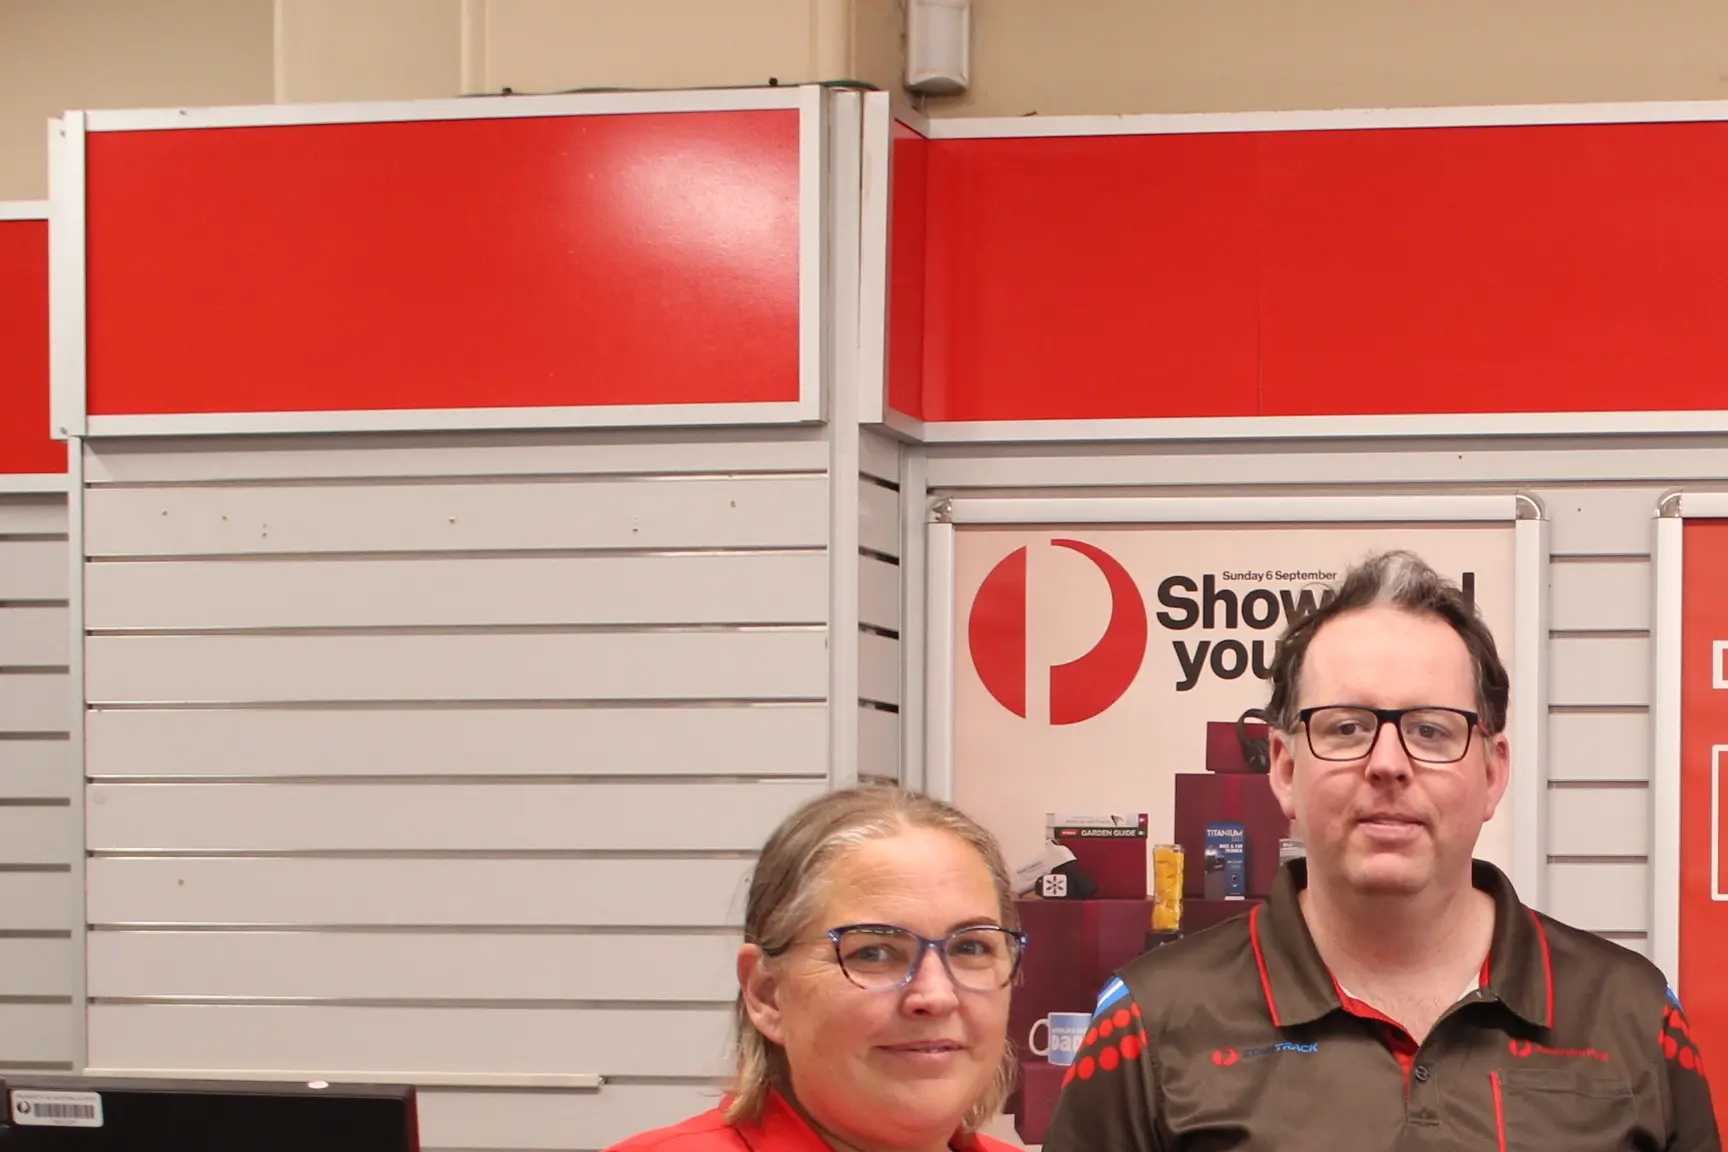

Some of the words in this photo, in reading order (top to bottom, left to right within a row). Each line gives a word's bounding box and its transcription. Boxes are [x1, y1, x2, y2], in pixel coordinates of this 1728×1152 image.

[1222, 569, 1264, 582] Sunday
[1265, 570, 1274, 581] 6
[1275, 570, 1337, 582] September
[1081, 829, 1112, 837] GARDEN
[1113, 829, 1136, 837] GUIDE
[1206, 829, 1243, 837] TITANIUM
